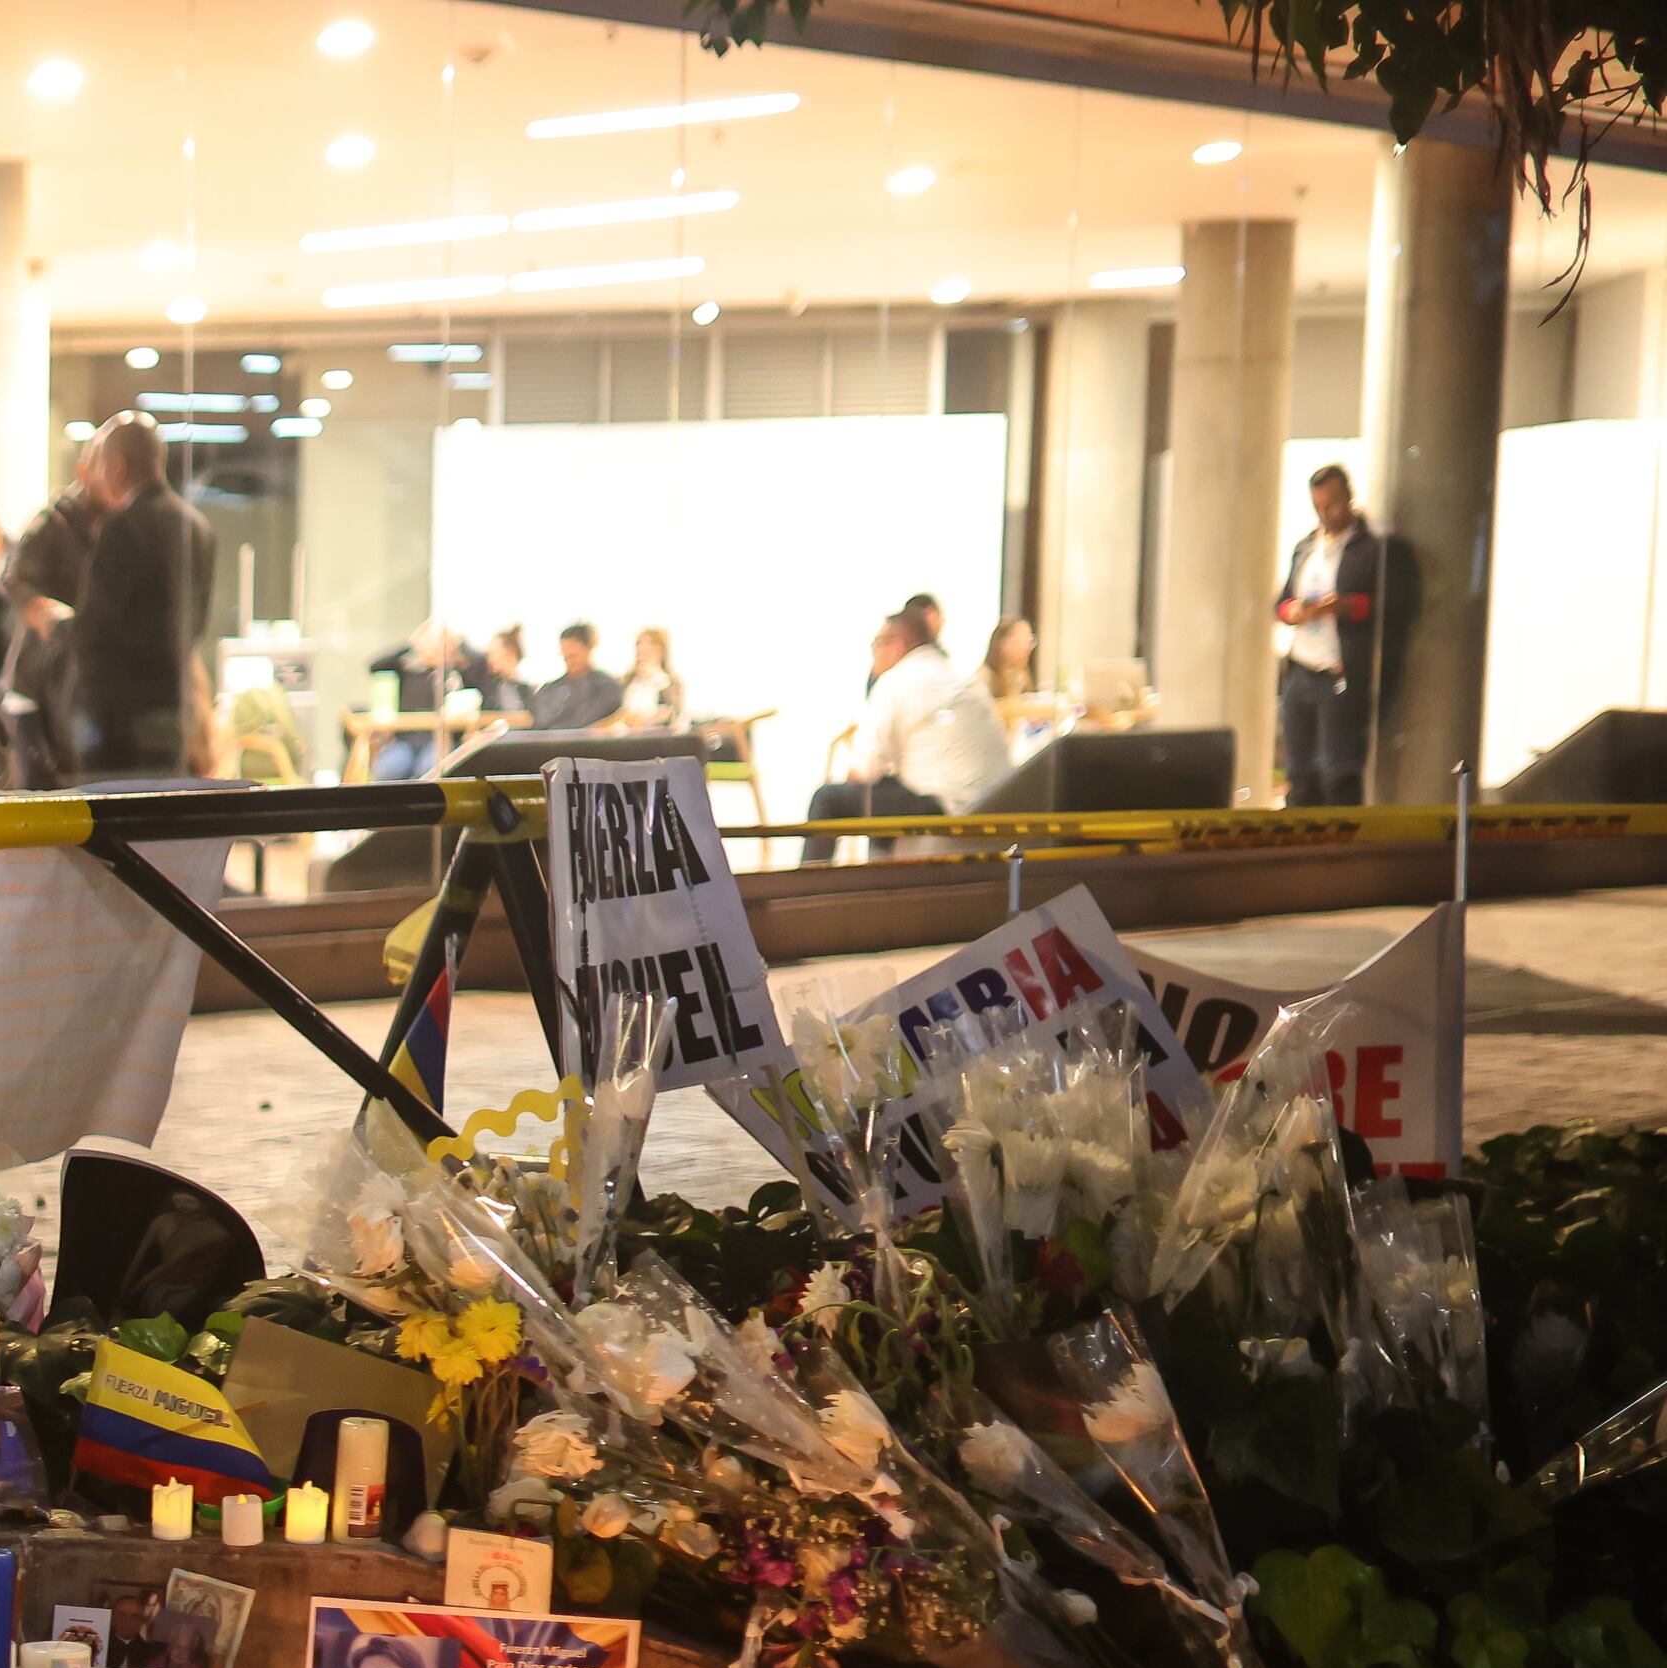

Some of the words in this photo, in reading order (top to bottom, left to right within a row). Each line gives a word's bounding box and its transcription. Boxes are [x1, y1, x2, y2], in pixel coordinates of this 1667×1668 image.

[568, 779, 711, 904] FUERZA
[576, 942, 764, 1088] MUEL
[105, 1374, 149, 1401] FUERZA
[153, 1389, 231, 1429] MIGUEL
[544, 1645, 587, 1659] Miguel
